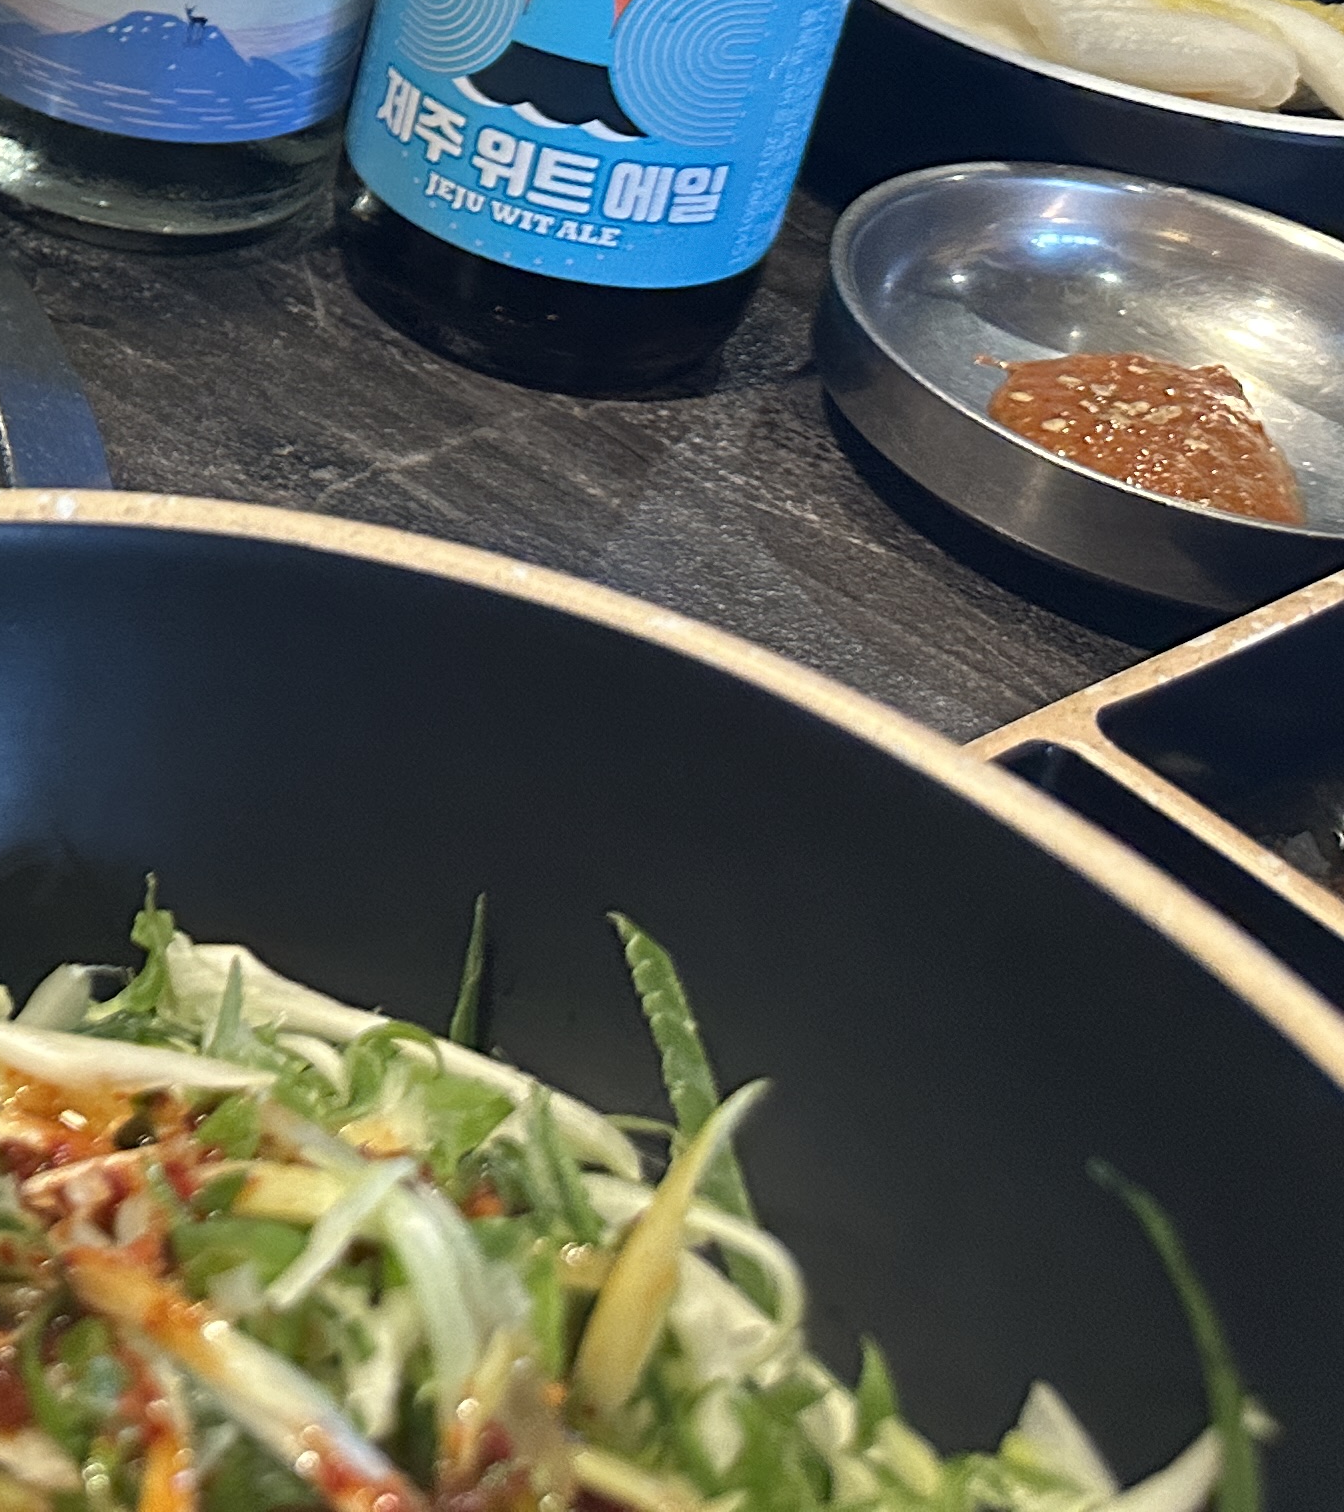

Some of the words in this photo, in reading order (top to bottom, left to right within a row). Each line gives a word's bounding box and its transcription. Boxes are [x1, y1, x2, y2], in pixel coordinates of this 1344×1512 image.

[376, 65, 467, 164] 제주
[472, 127, 602, 215] 위트
[603, 162, 731, 225] 에일
[424, 171, 487, 213] JEJU
[490, 200, 556, 236] WIT
[556, 222, 622, 248] ALE
